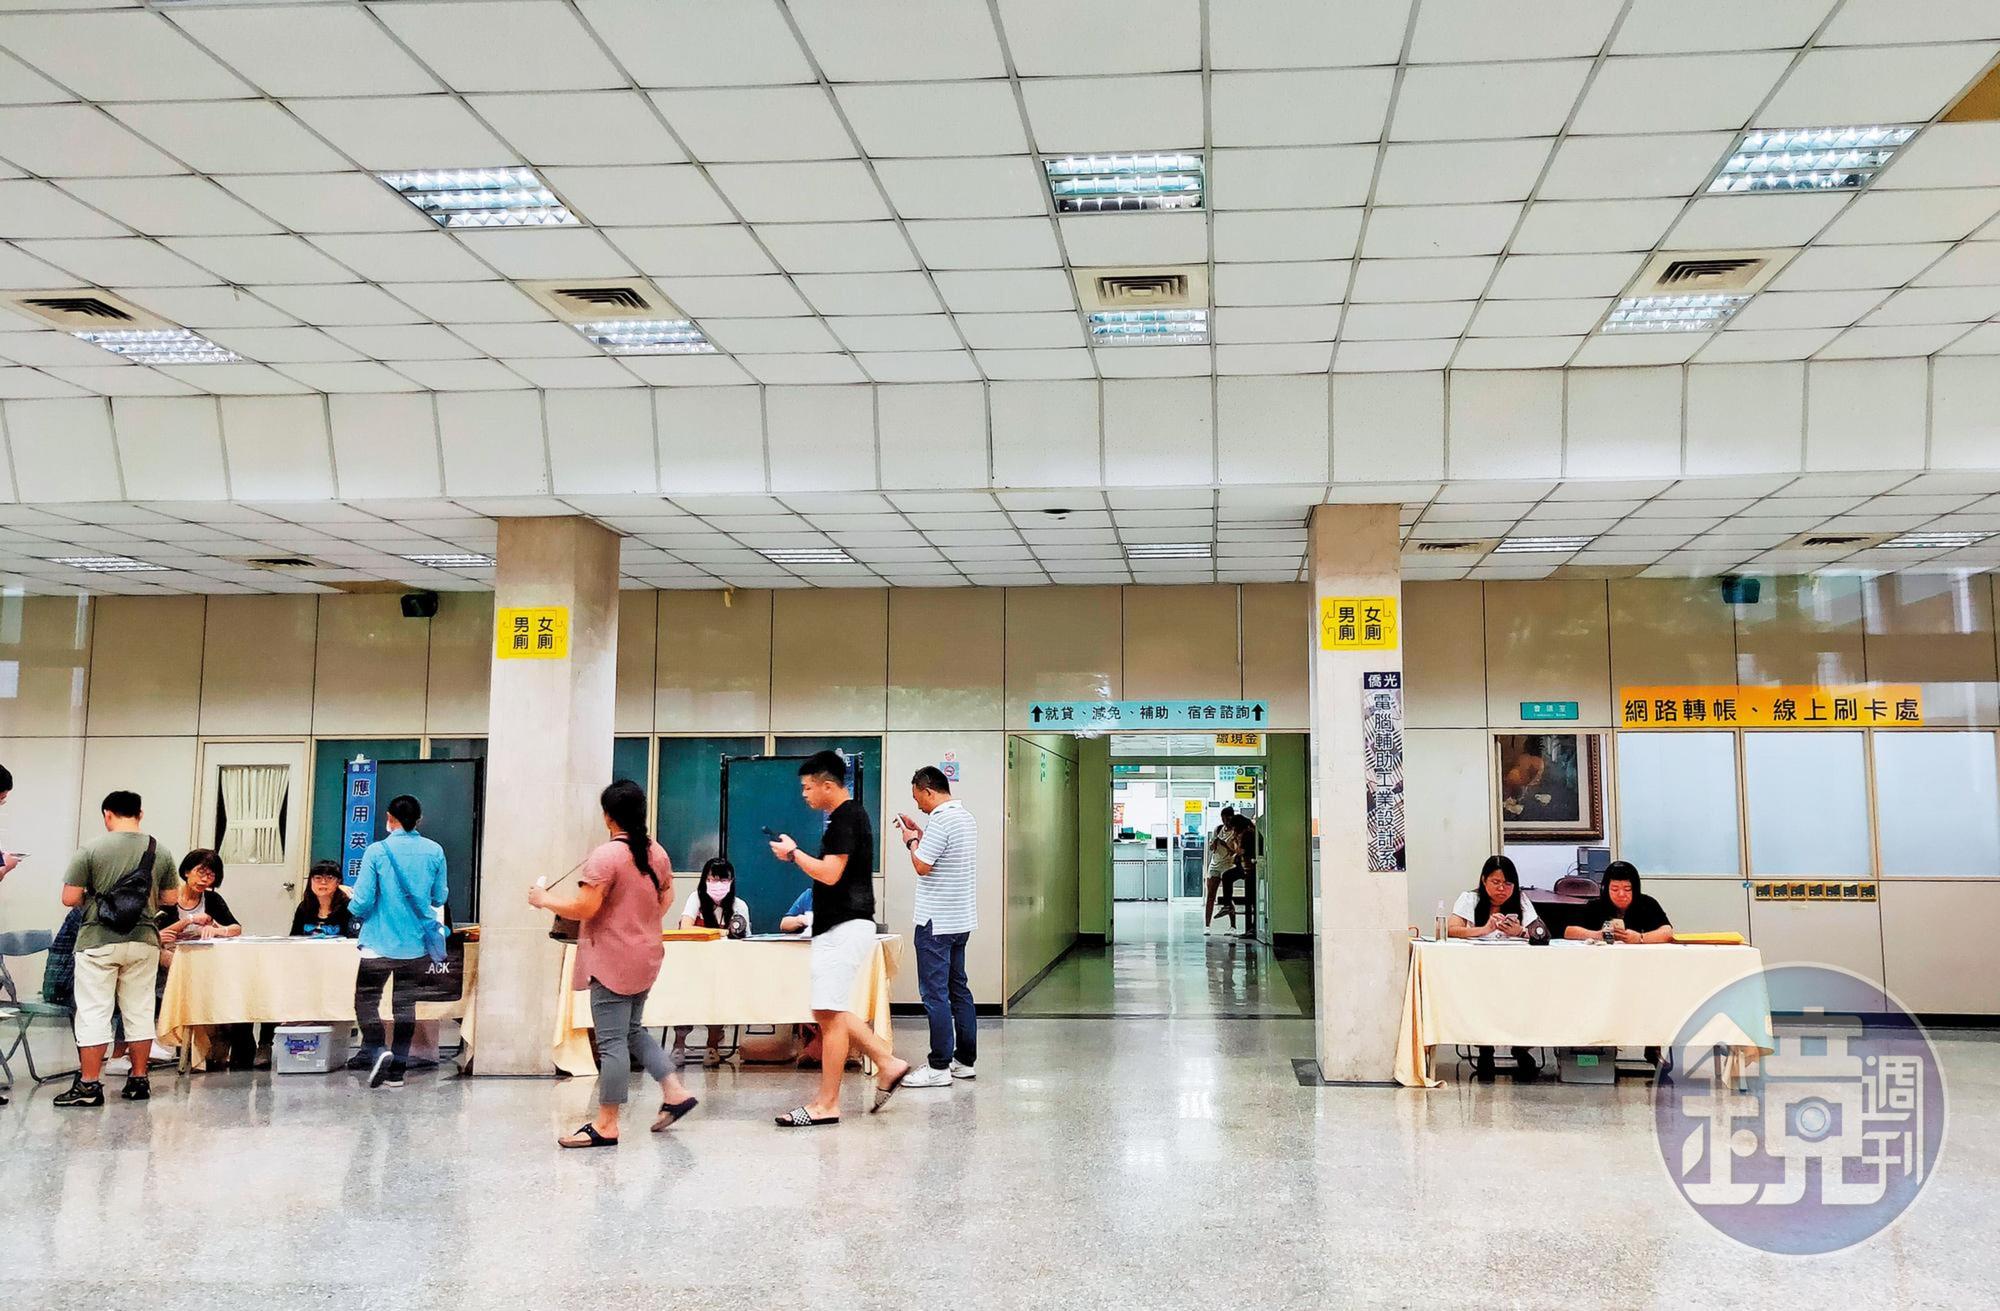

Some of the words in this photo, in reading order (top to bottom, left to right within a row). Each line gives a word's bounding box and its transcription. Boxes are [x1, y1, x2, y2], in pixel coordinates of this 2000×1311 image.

[513, 616, 529, 650] 男廁
[537, 616, 554, 650] 女廁
[1338, 606, 1355, 640] 男廁
[1364, 606, 1382, 640] 女廁
[1368, 674, 1398, 688] 僑光
[1045, 705, 1250, 721] 就貸、減免、補助、宿舍諮詢
[1625, 698, 1920, 722] 網路轉帳、線上刷卡處
[1374, 693, 1397, 867] 電腦輔助工業設計系
[425, 962, 450, 974] ACK
